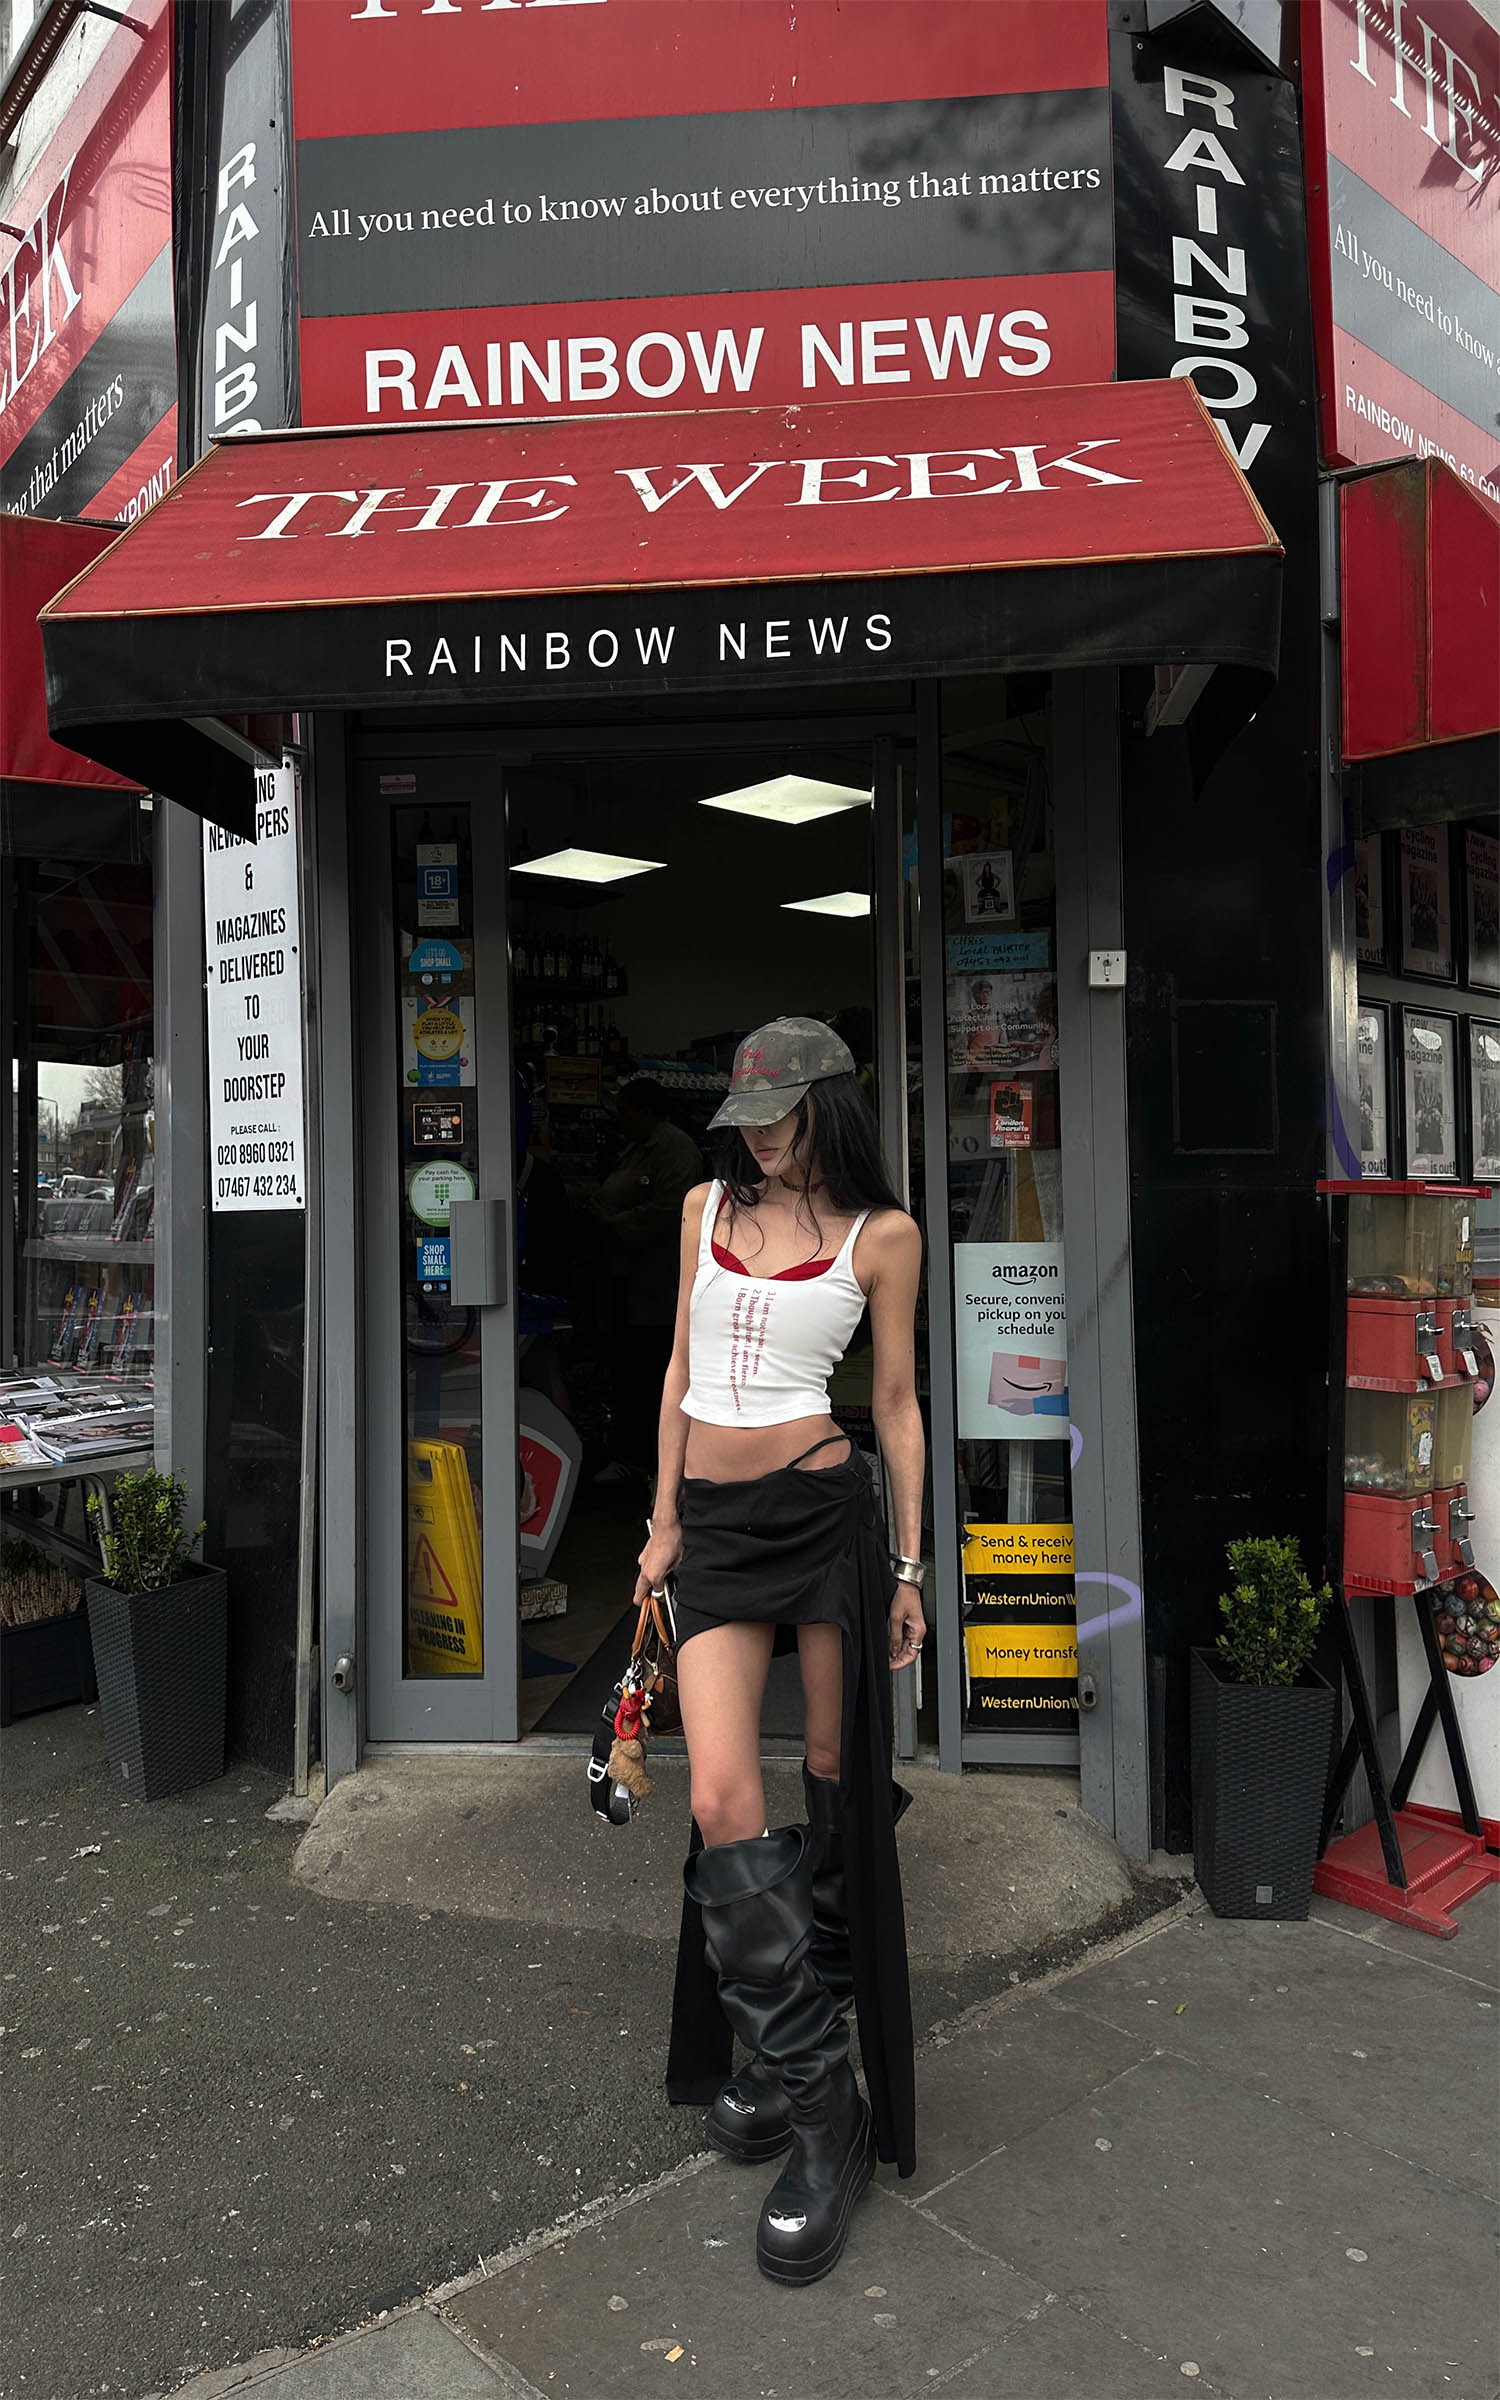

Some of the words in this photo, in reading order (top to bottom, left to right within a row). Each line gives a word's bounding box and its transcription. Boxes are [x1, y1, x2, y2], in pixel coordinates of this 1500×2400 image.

[309, 211, 352, 237] All
[357, 213, 414, 240] you
[421, 199, 495, 229] need
[502, 201, 531, 223] to
[539, 195, 627, 221] know
[635, 187, 723, 215] about
[731, 177, 900, 212] everything
[908, 172, 972, 198] that
[979, 168, 1100, 194] matters
[1334, 223, 1359, 266] All
[1362, 249, 1393, 292] you
[1396, 278, 1434, 323] need
[1436, 306, 1452, 336] to
[1455, 316, 1494, 369] know
[366, 328, 764, 412] RAINBOW
[802, 310, 1050, 387] NEWS
[1345, 384, 1414, 450] RAINBOW
[29, 447, 61, 511] that
[61, 374, 125, 476] matters
[236, 475, 577, 540] THE
[615, 440, 1142, 508] WEEK
[386, 626, 676, 677] RAINBOW
[719, 613, 892, 661] NEWS
[1406, 831, 1436, 850] cycling
[1471, 852, 1497, 871] cycling
[245, 863, 254, 890] &
[217, 908, 285, 945] MAGAZINES
[220, 950, 284, 984] DELIVERED
[245, 995, 259, 1020] TO
[950, 1024, 984, 1034] Support
[1001, 1023, 1050, 1034] Community
[238, 1034, 269, 1061] YOUR
[224, 1073, 285, 1102] DOORSTEP
[231, 1124, 257, 1135] PLEASE
[218, 1145, 236, 1165] 020
[240, 1143, 265, 1164] 8960
[269, 1141, 295, 1162] 0321
[1368, 1158, 1387, 1174] out!
[1430, 1161, 1437, 1174] is
[1438, 1161, 1456, 1175] out!
[219, 1177, 250, 1197] 07467
[254, 1176, 273, 1196] 432
[276, 1175, 297, 1195] 234
[424, 1245, 445, 1255] SHOP
[422, 1255, 447, 1265] SMALL
[425, 1265, 444, 1276] HERE
[992, 1265, 1058, 1278] amazon
[966, 1294, 1012, 1306] Secure,
[1015, 1294, 1065, 1305] conveni
[978, 1309, 1020, 1322] pickup
[1025, 1312, 1041, 1320] on
[998, 1323, 1055, 1335] schedule
[978, 1536, 1014, 1547] Send
[1019, 1536, 1028, 1547] &
[1032, 1536, 1073, 1547] receiv
[993, 1555, 1037, 1566] money
[1042, 1552, 1072, 1563] here
[978, 1591, 1066, 1606] WesternUnion
[454, 1616, 466, 1635] IN
[416, 1627, 466, 1655] PROGRESS
[987, 1648, 1030, 1661] Money
[981, 1696, 1070, 1710] WesternUnion
